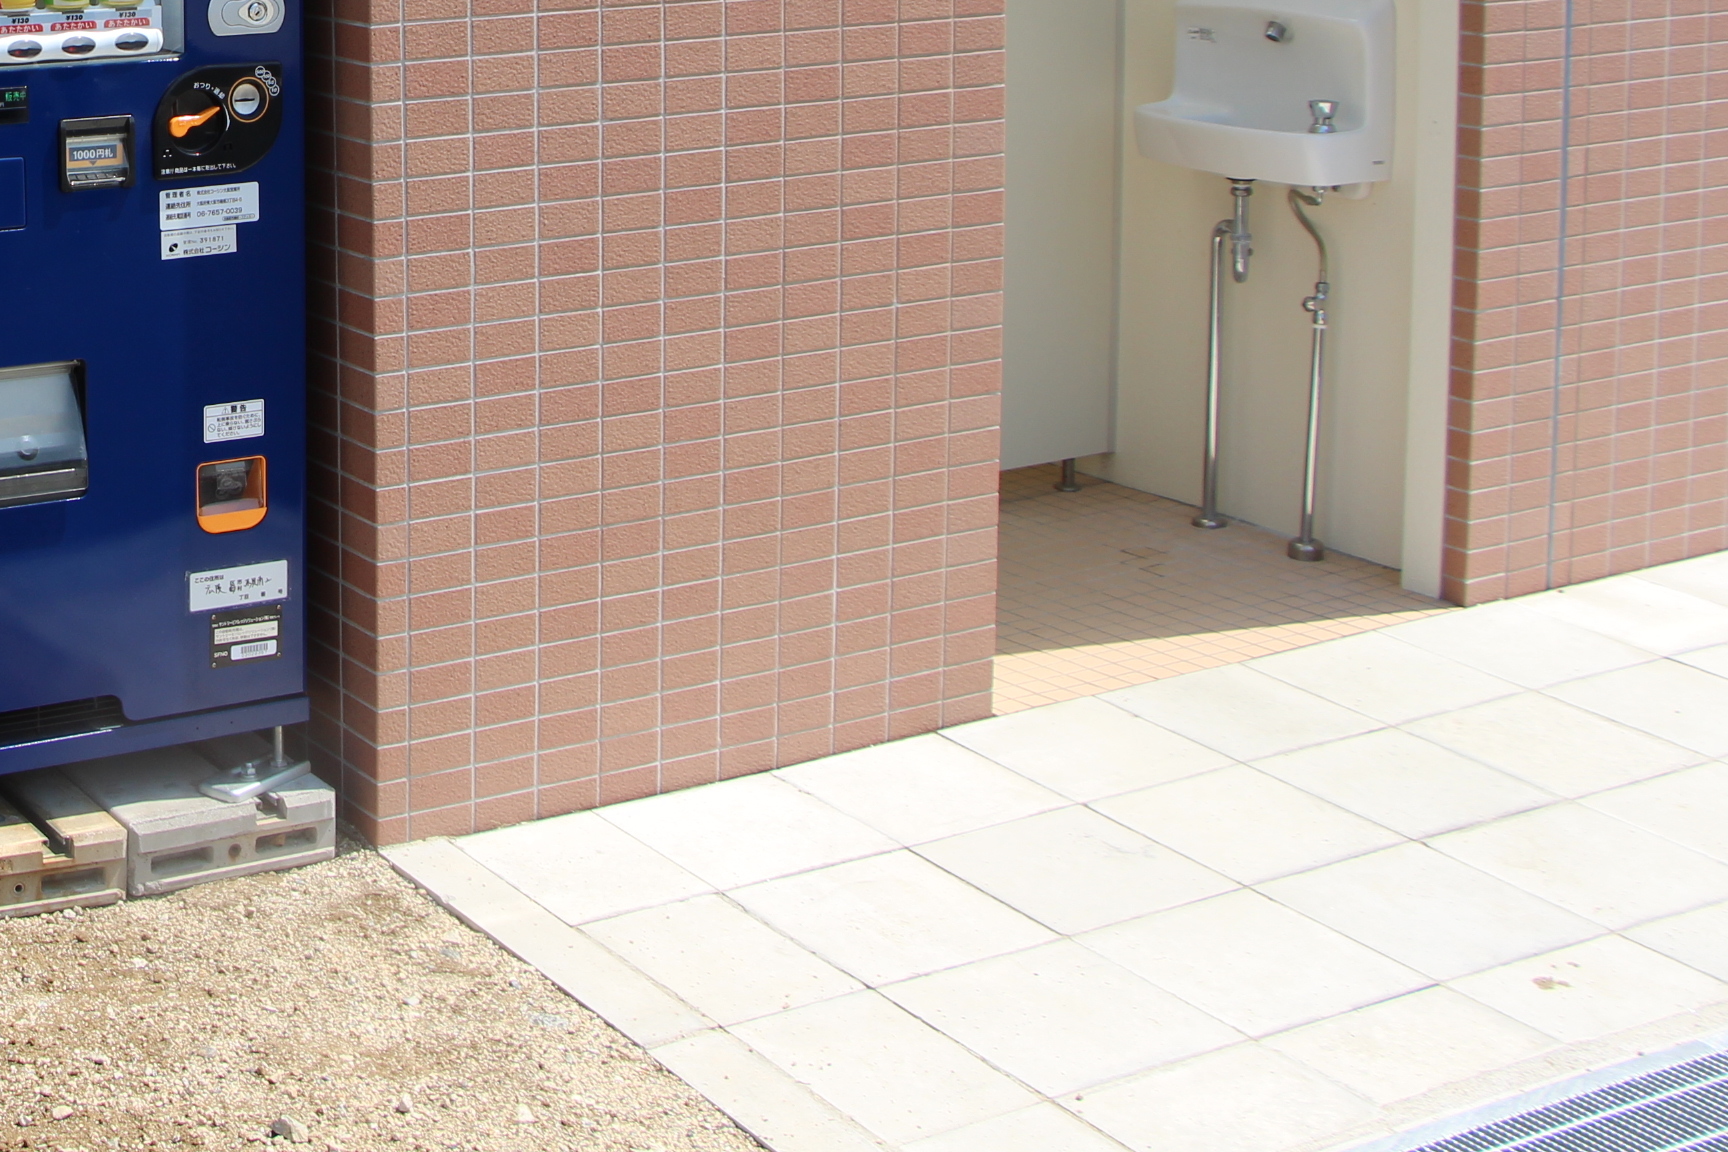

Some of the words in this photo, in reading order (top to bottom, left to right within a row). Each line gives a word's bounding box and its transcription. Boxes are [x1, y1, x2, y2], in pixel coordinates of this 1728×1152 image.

[108, 19, 146, 27] あたたかい
[0, 26, 39, 34] あたたかい
[72, 148, 114, 160] 1000円札
[165, 190, 191, 199] 管理者名
[165, 201, 191, 210] 連絡先住所
[196, 207, 243, 217] 06-7657-0039
[199, 236, 224, 244] 391871
[183, 244, 231, 255] 株式会社コーシン
